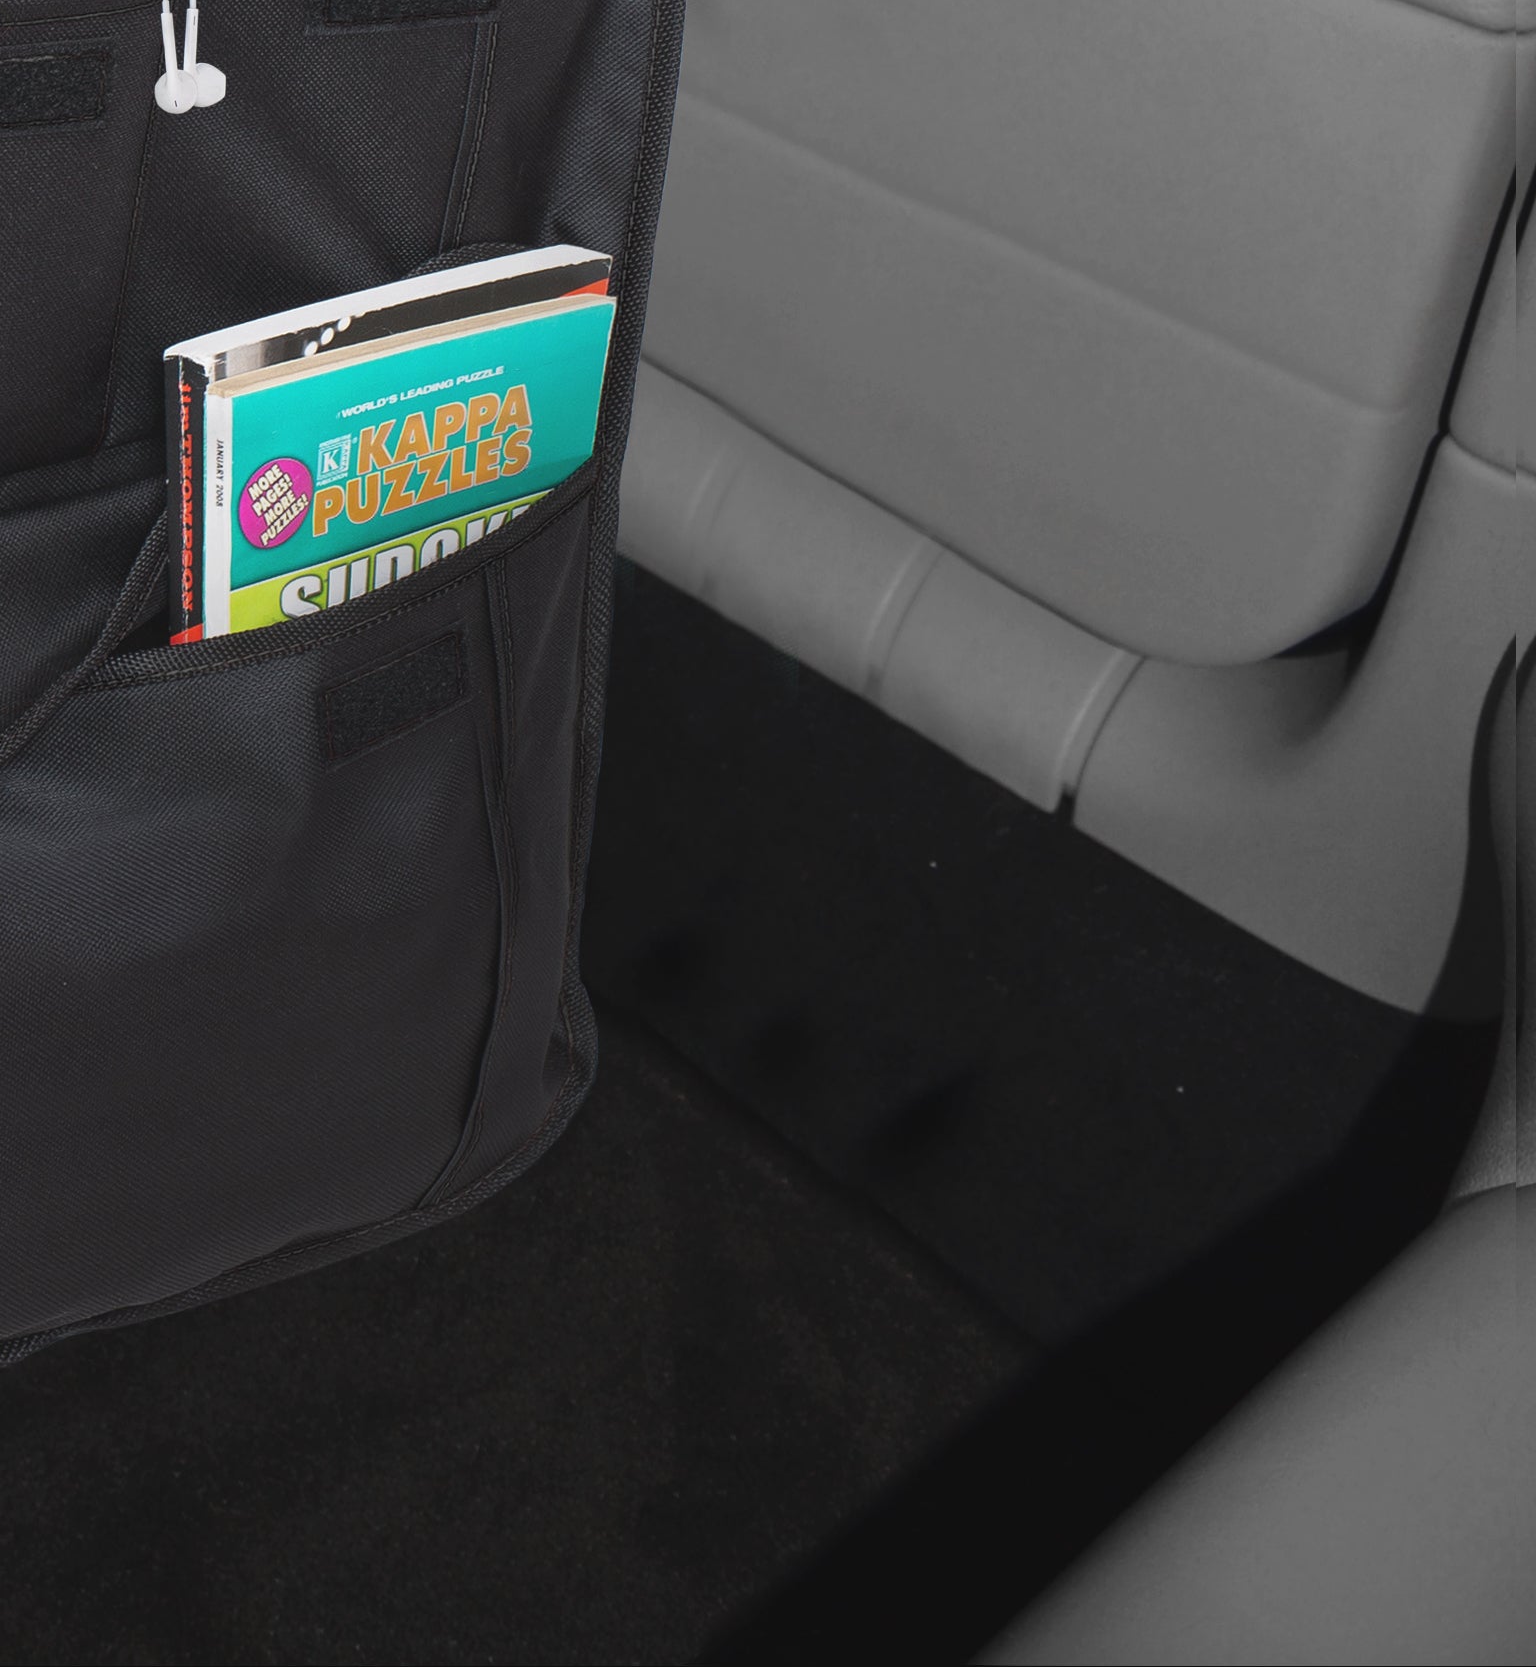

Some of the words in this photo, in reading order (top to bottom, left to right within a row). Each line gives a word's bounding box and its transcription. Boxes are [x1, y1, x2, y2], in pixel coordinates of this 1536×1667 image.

[341, 394, 398, 419] WORLD'S
[400, 378, 454, 401] LEADING
[456, 365, 505, 385] PUZZLE
[356, 384, 532, 475] KAPPA
[216, 439, 224, 481] JANUARY
[248, 464, 283, 502] MORE
[312, 428, 533, 538] PUZZLES
[215, 484, 224, 508] 2008
[251, 473, 293, 516] PAGES!
[264, 489, 296, 527] MORE
[182, 434, 193, 611] THOMPSON
[260, 493, 309, 547] PUZZLES!
